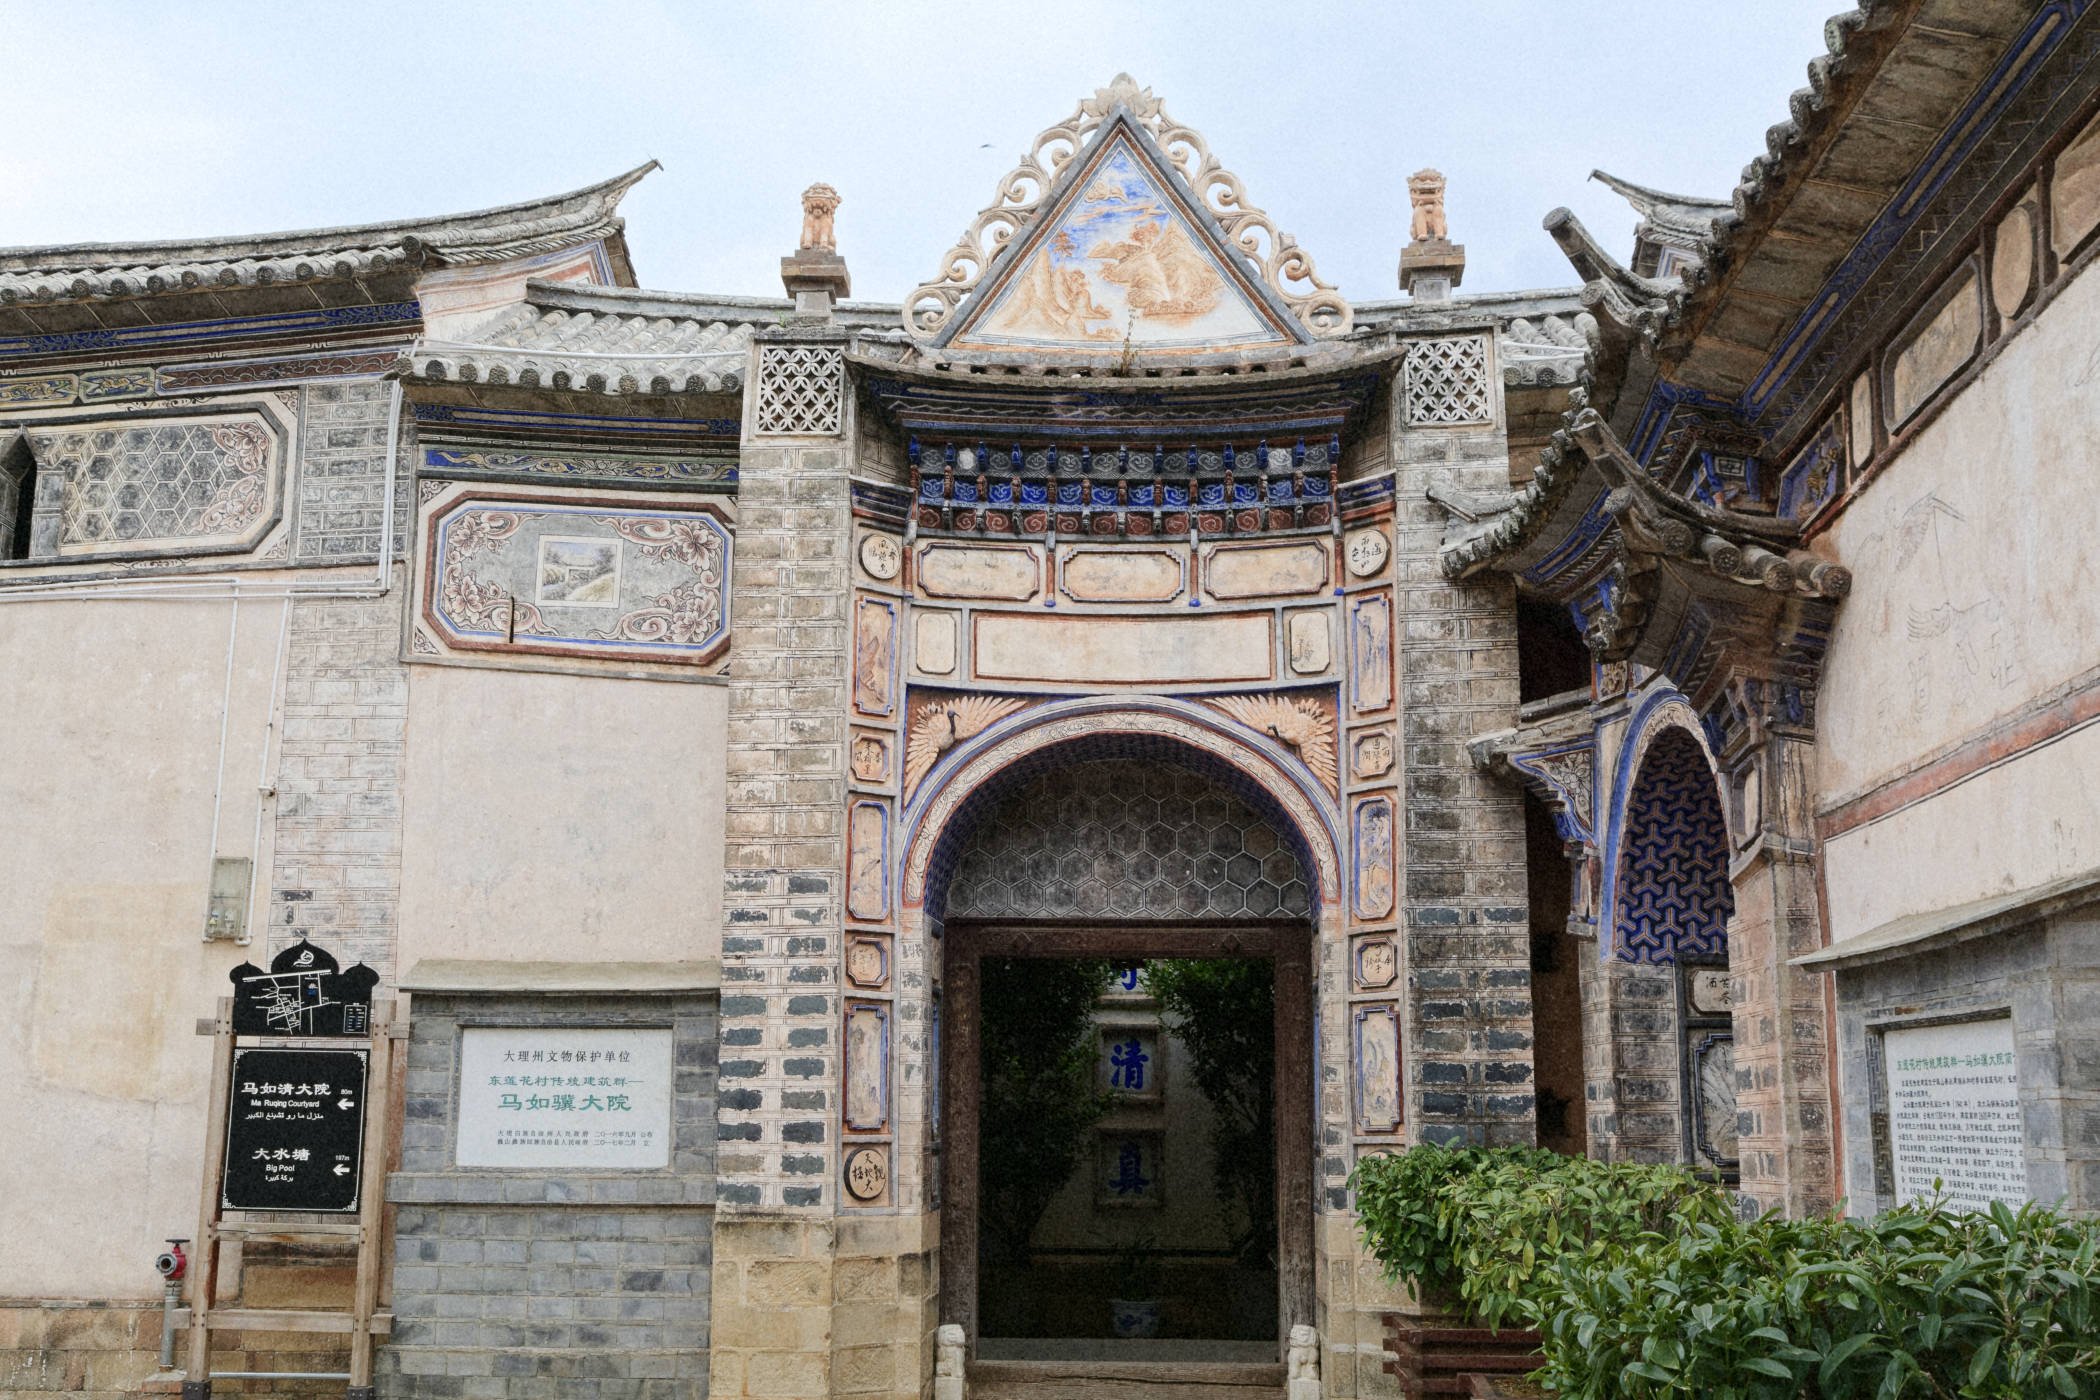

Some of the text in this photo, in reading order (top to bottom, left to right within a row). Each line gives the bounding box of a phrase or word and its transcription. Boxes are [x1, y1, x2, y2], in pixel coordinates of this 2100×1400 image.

[503, 1049, 631, 1063] 大理州文物保护单位
[241, 1081, 332, 1096] 马如清大院
[250, 1099, 320, 1109] Ma Ruqing Courtyard
[497, 1093, 633, 1112] 马如骥大院
[297, 1111, 306, 1119] ما
[251, 1147, 311, 1161] 大水塘
[265, 1164, 296, 1173] Big Pool
